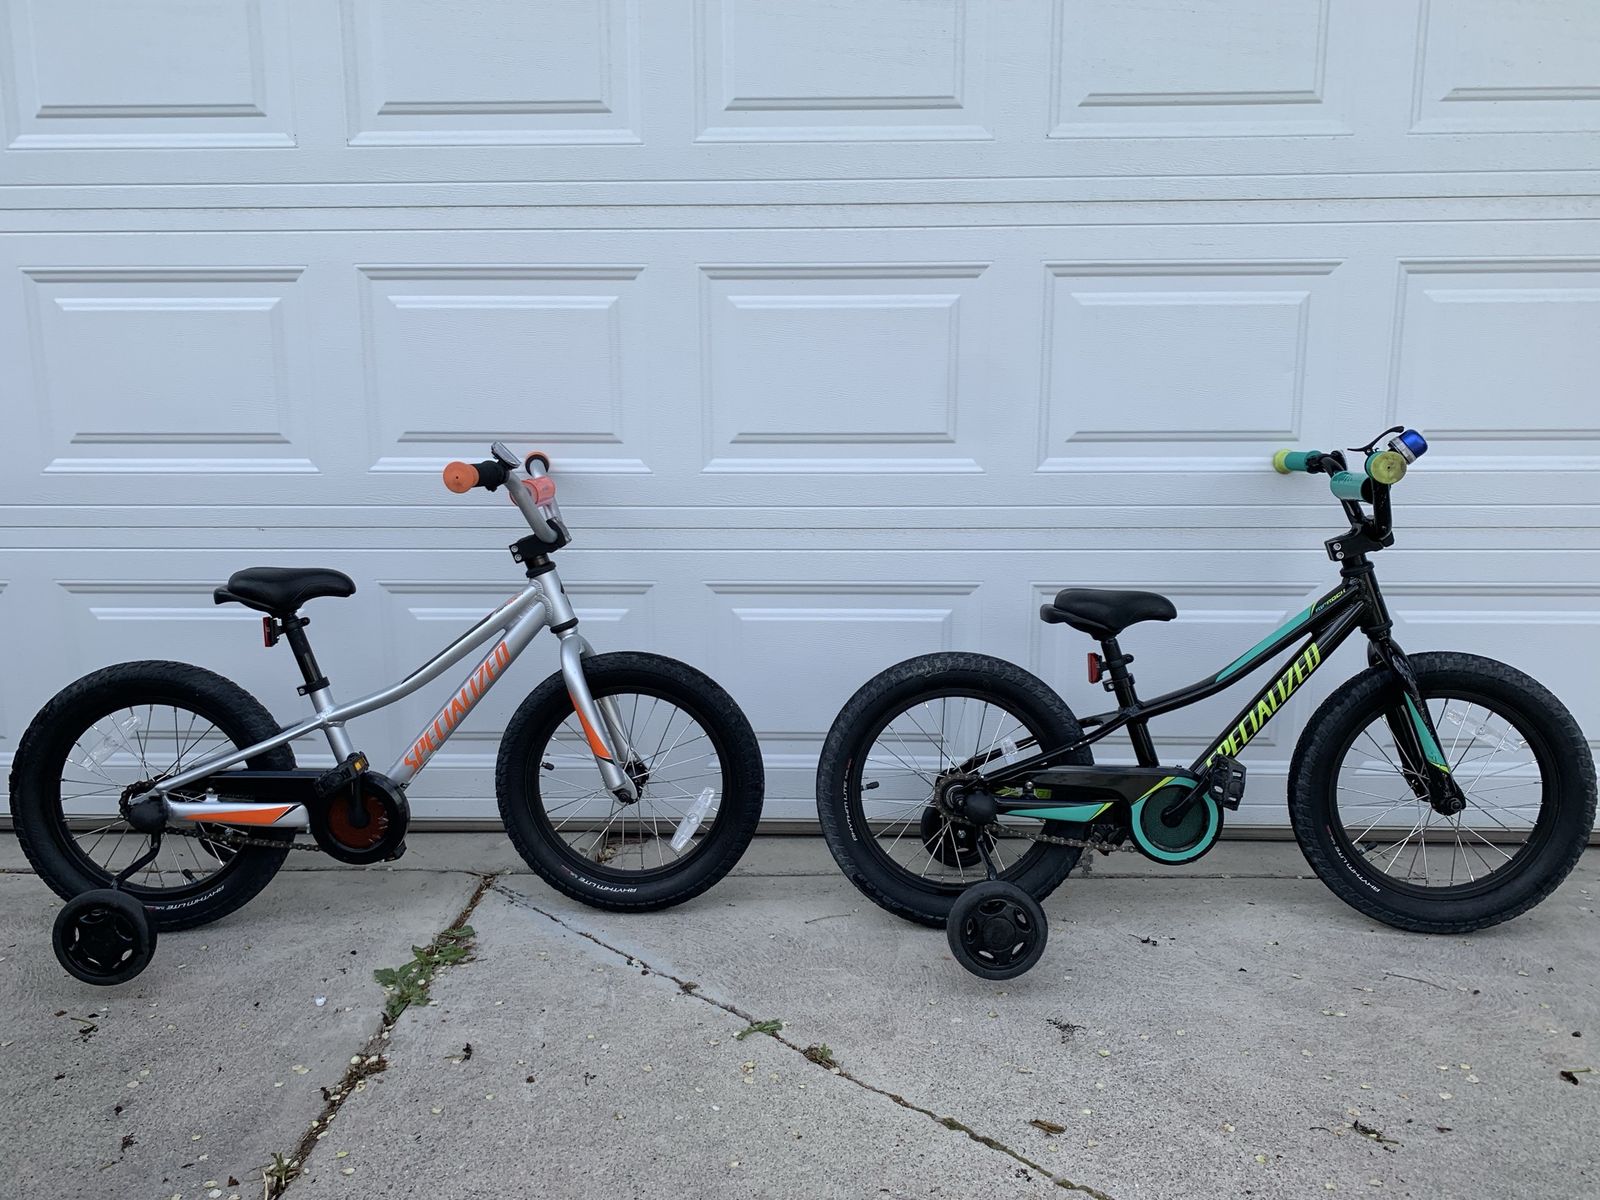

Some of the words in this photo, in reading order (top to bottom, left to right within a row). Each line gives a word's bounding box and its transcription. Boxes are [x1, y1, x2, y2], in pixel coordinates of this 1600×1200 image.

[404, 640, 511, 769] SPECIALIZED
[1335, 846, 1347, 863] LITE
[1346, 863, 1381, 893] RHYTHM
[187, 884, 225, 907] RHYTHM
